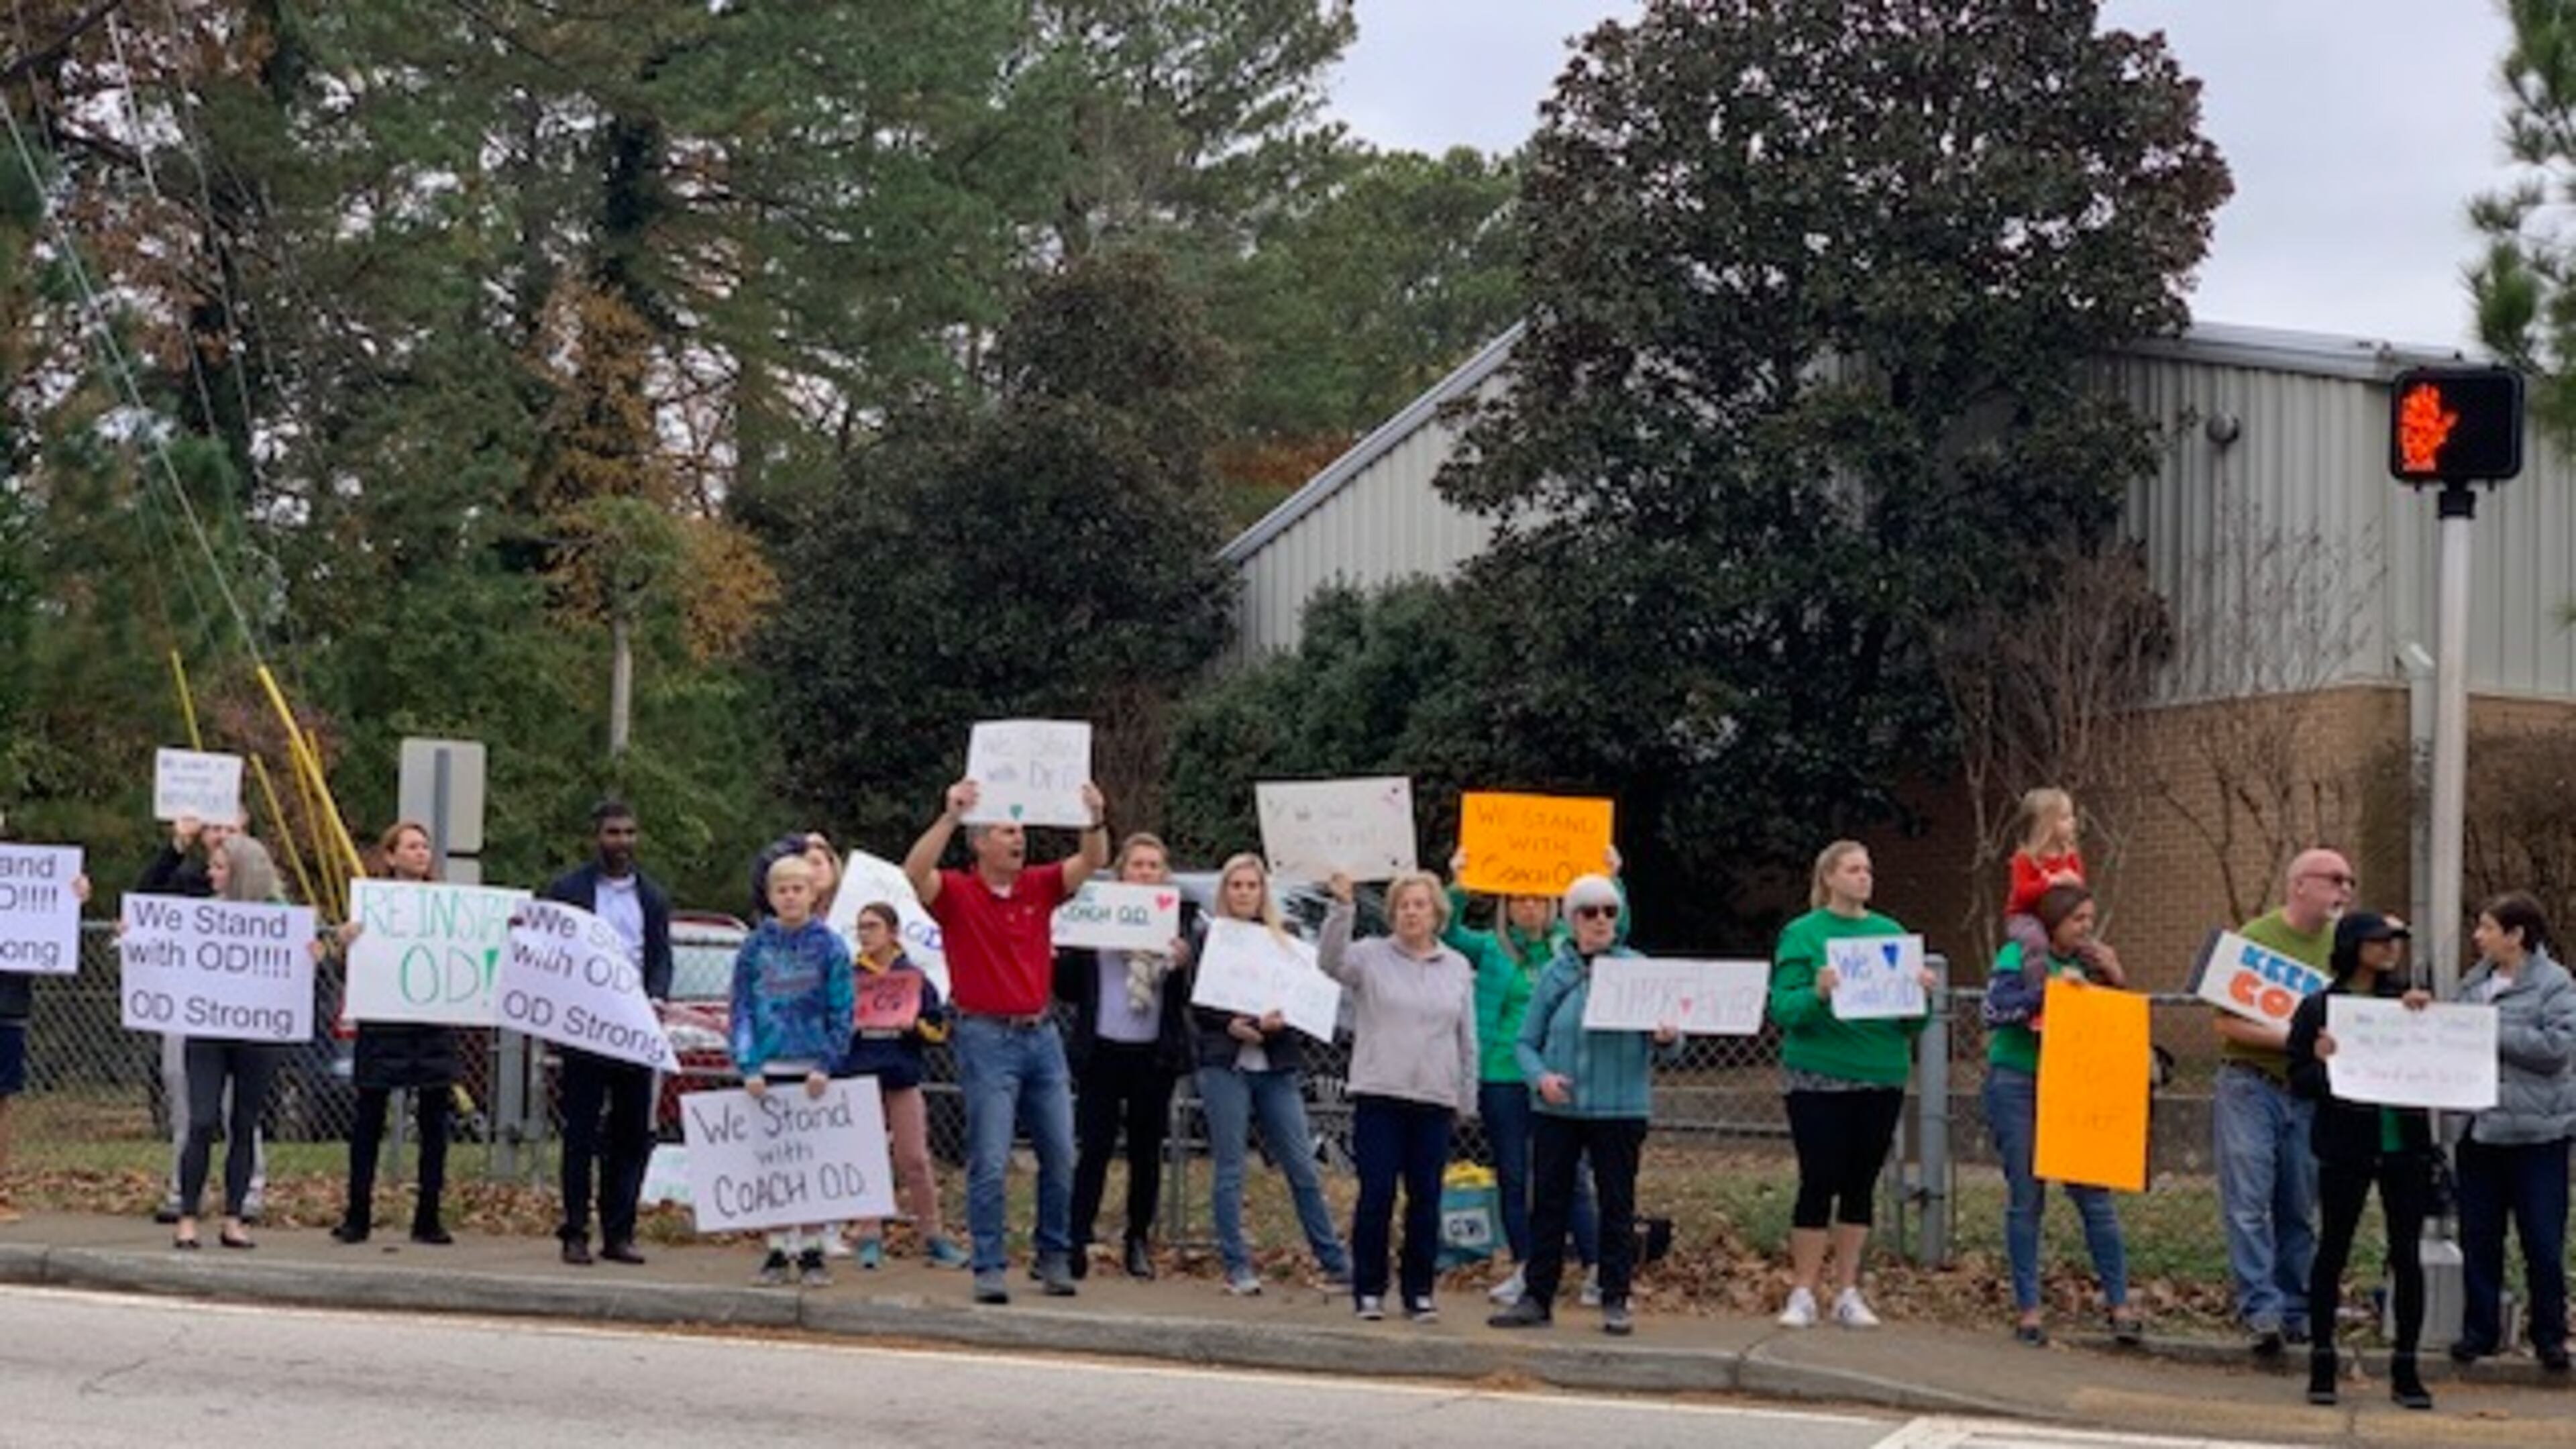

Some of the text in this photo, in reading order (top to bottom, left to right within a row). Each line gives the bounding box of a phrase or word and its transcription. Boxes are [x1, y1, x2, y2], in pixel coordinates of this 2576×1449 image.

[133, 901, 287, 939] We Stand
[525, 906, 578, 939] We
[126, 938, 290, 979] with OD!!!!
[400, 943, 499, 1008] OD!
[511, 940, 574, 977] with
[2239, 944, 2323, 996] KEEP
[129, 989, 294, 1038] OD Strong
[2228, 970, 2294, 1019] CO
[503, 989, 666, 1064] OD Strong
[690, 1087, 855, 1144] We Stand
[752, 1140, 813, 1166] with
[713, 1173, 809, 1219] COACH
